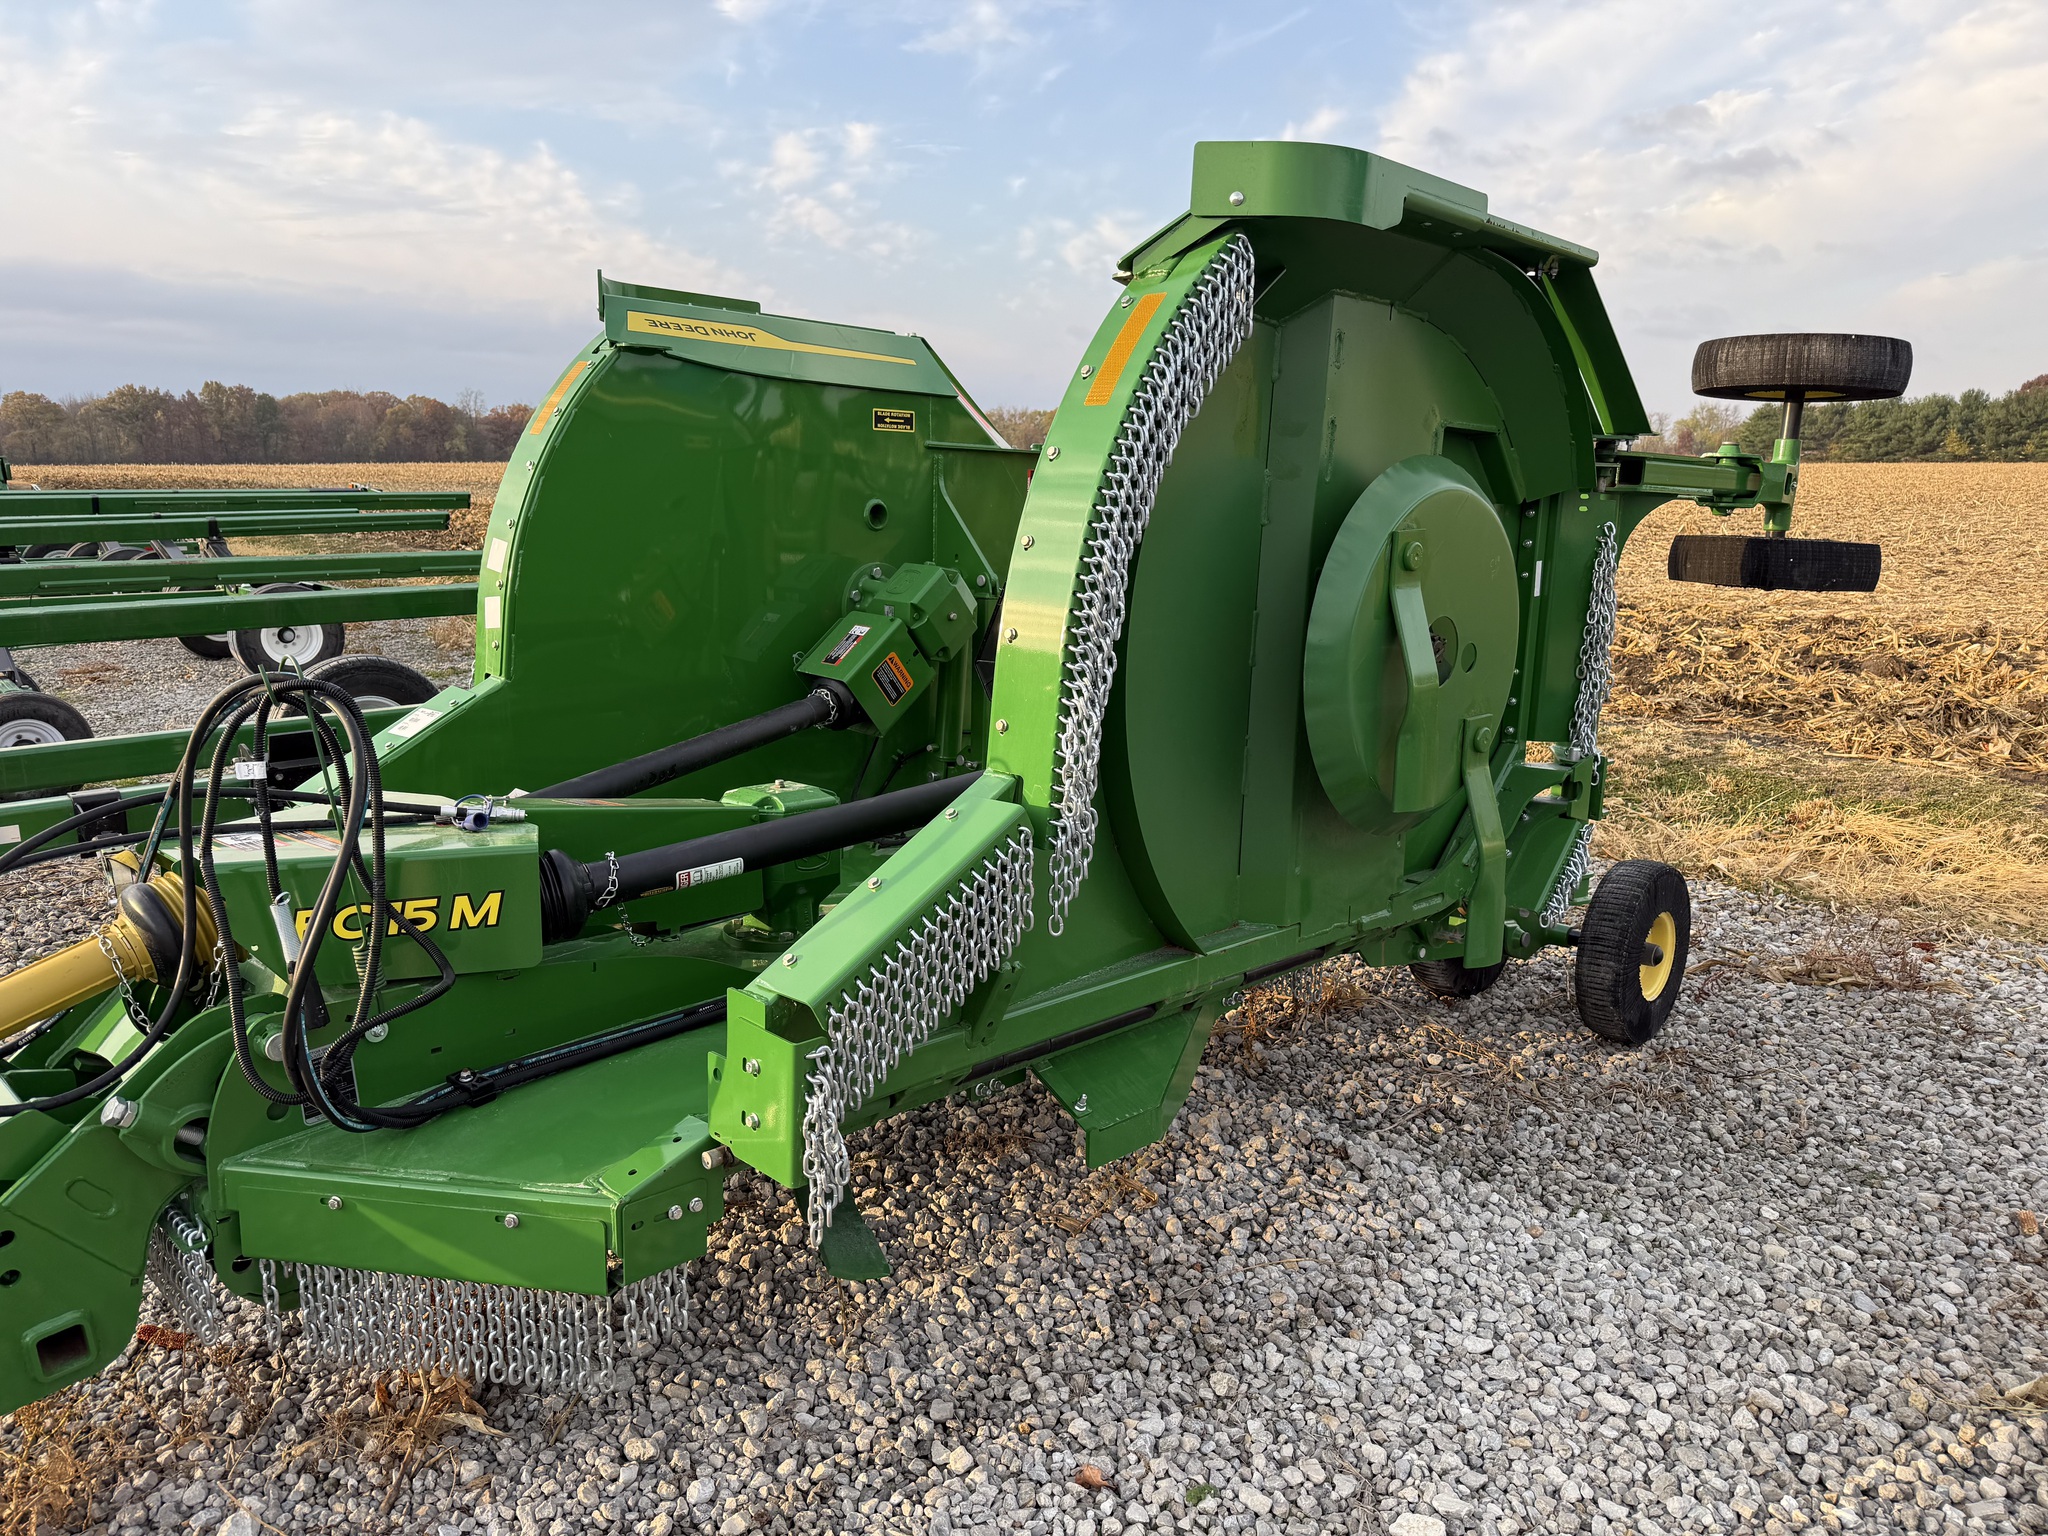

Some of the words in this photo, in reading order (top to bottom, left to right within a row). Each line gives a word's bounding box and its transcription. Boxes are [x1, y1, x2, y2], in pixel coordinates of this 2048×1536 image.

[644, 318, 710, 336] DEERE
[710, 327, 756, 342] JOHN
[893, 660, 912, 688] WARNING
